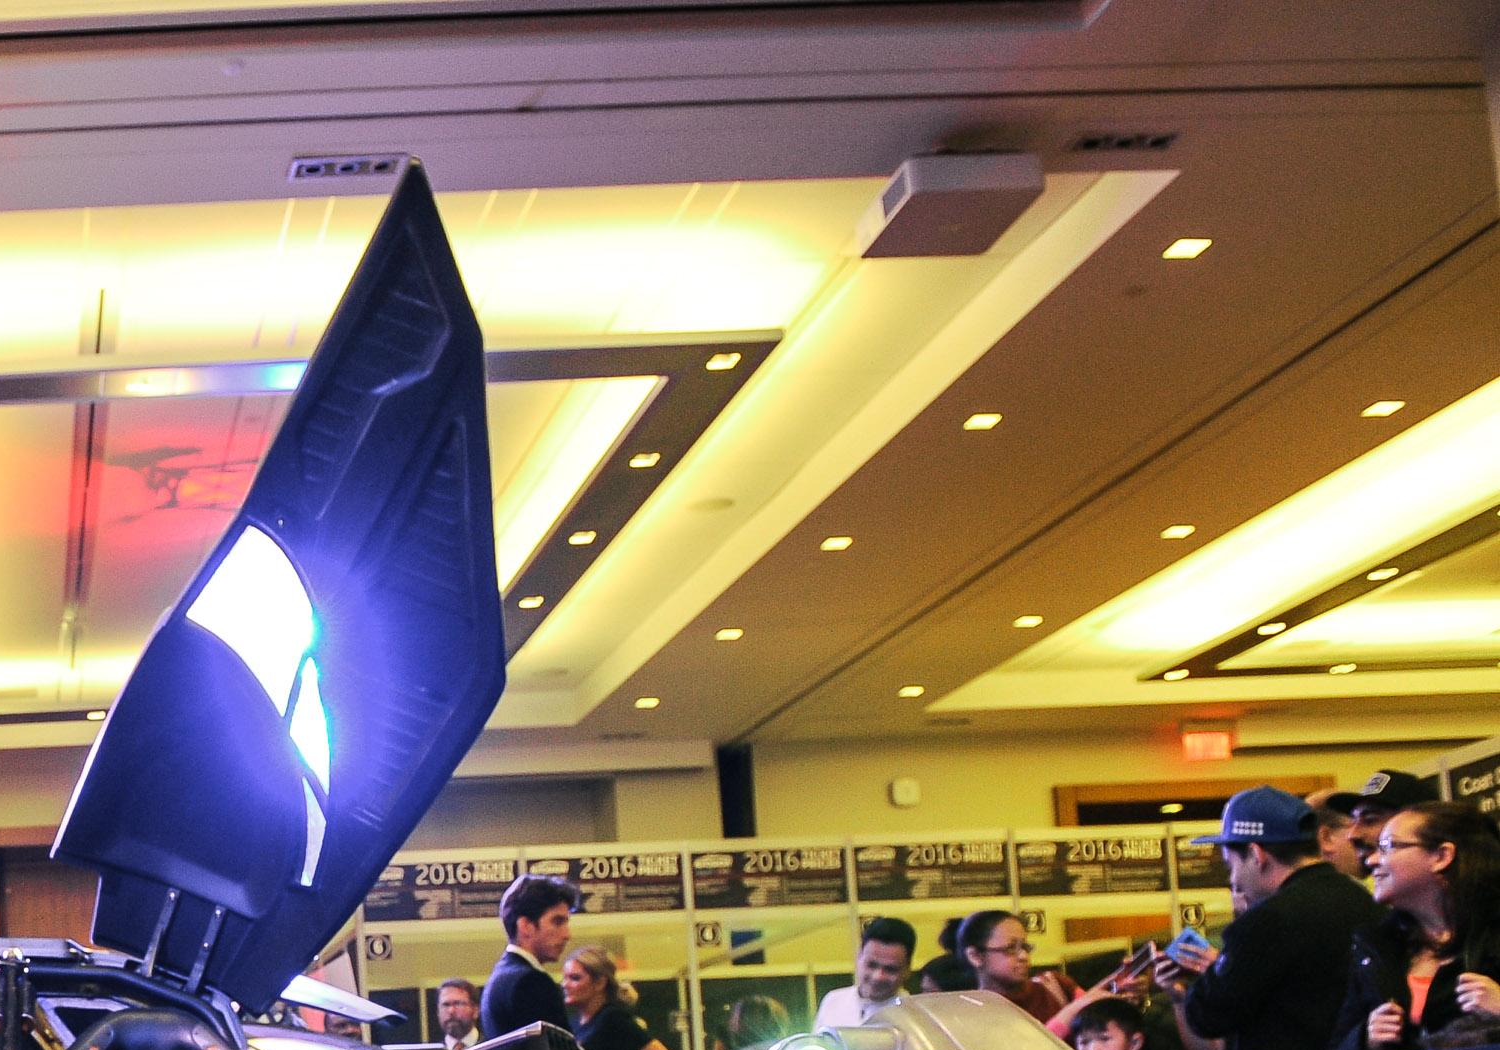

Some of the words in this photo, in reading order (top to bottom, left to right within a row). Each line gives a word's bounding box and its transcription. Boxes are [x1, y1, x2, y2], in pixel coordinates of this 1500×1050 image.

[743, 851, 800, 873] 2016
[907, 845, 962, 867] 2016
[1067, 840, 1122, 862] 2016
[415, 862, 472, 886] 2016
[579, 856, 637, 879] 2016
